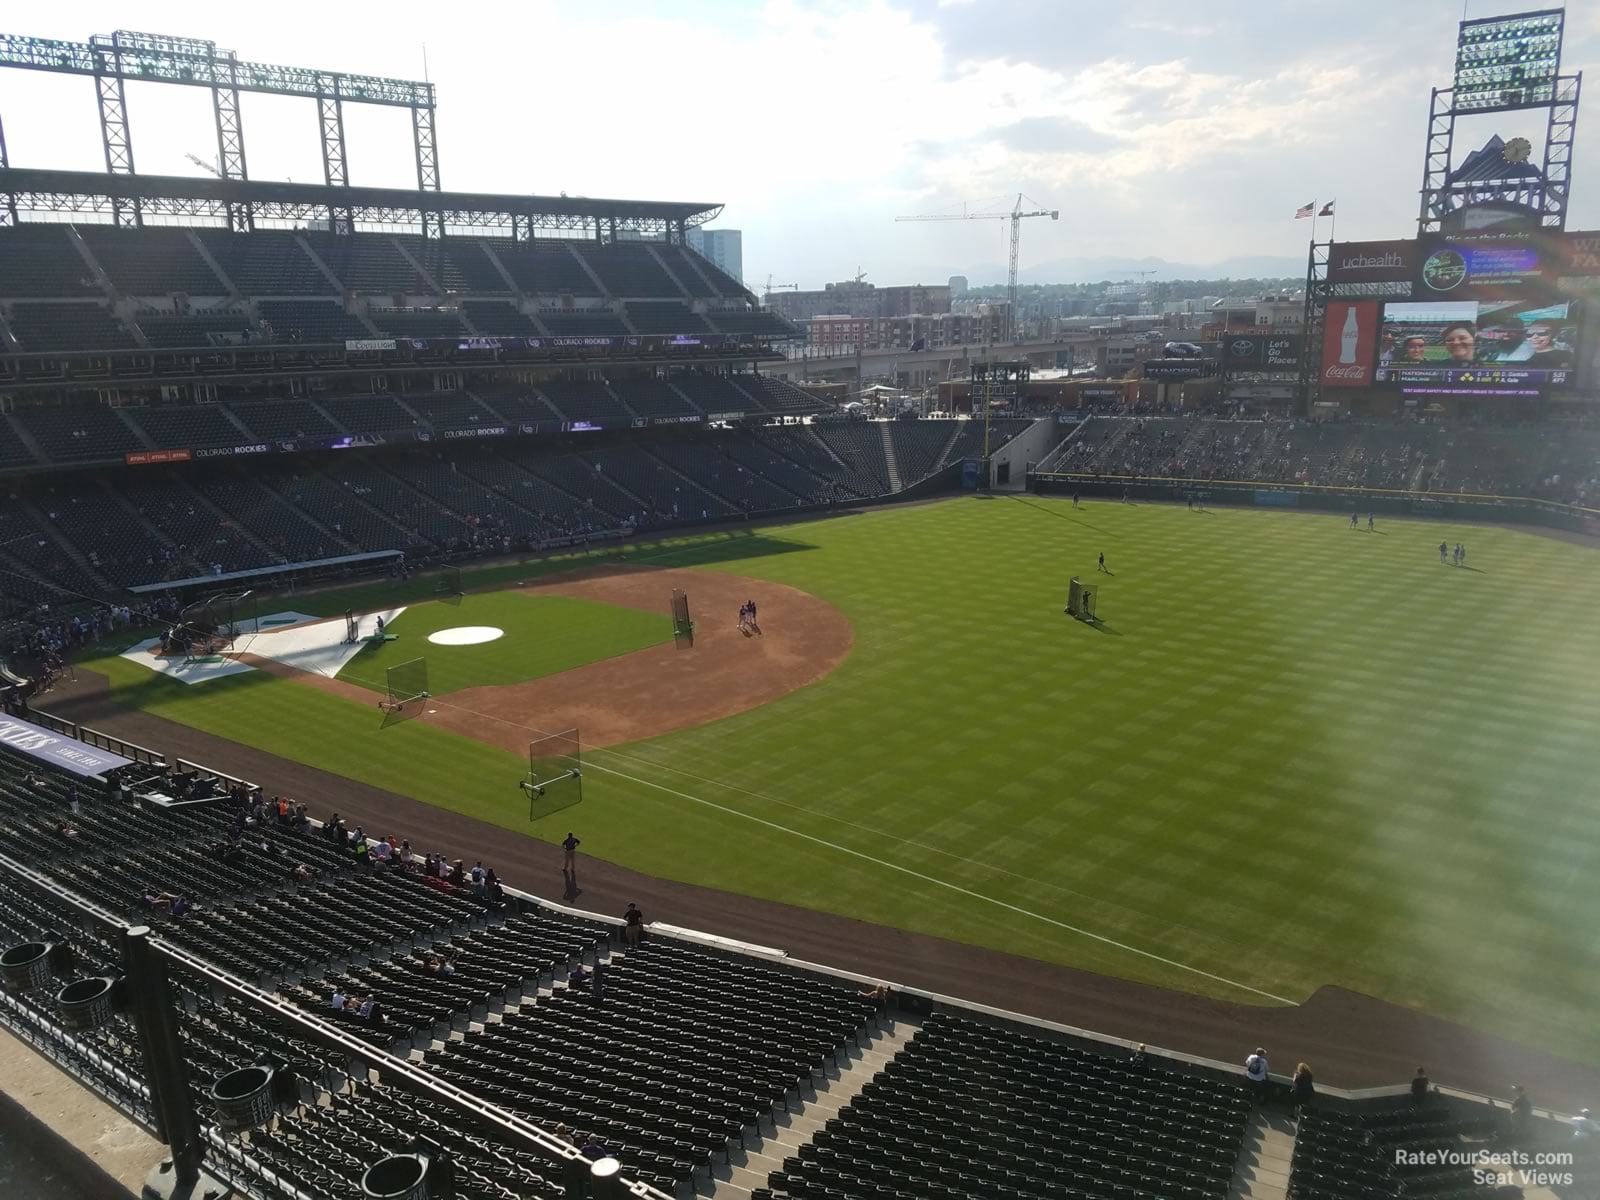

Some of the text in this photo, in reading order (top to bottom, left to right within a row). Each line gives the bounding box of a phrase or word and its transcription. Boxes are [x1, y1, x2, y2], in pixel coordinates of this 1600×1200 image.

[1342, 252, 1402, 269] uchealth
[553, 337, 610, 346] COLORADO ROCKIES
[1269, 340, 1289, 348] Let's
[1267, 356, 1297, 365] Places
[444, 427, 505, 438] COLORADO ROCKIES
[196, 444, 267, 457] COLORADO ROCKIES
